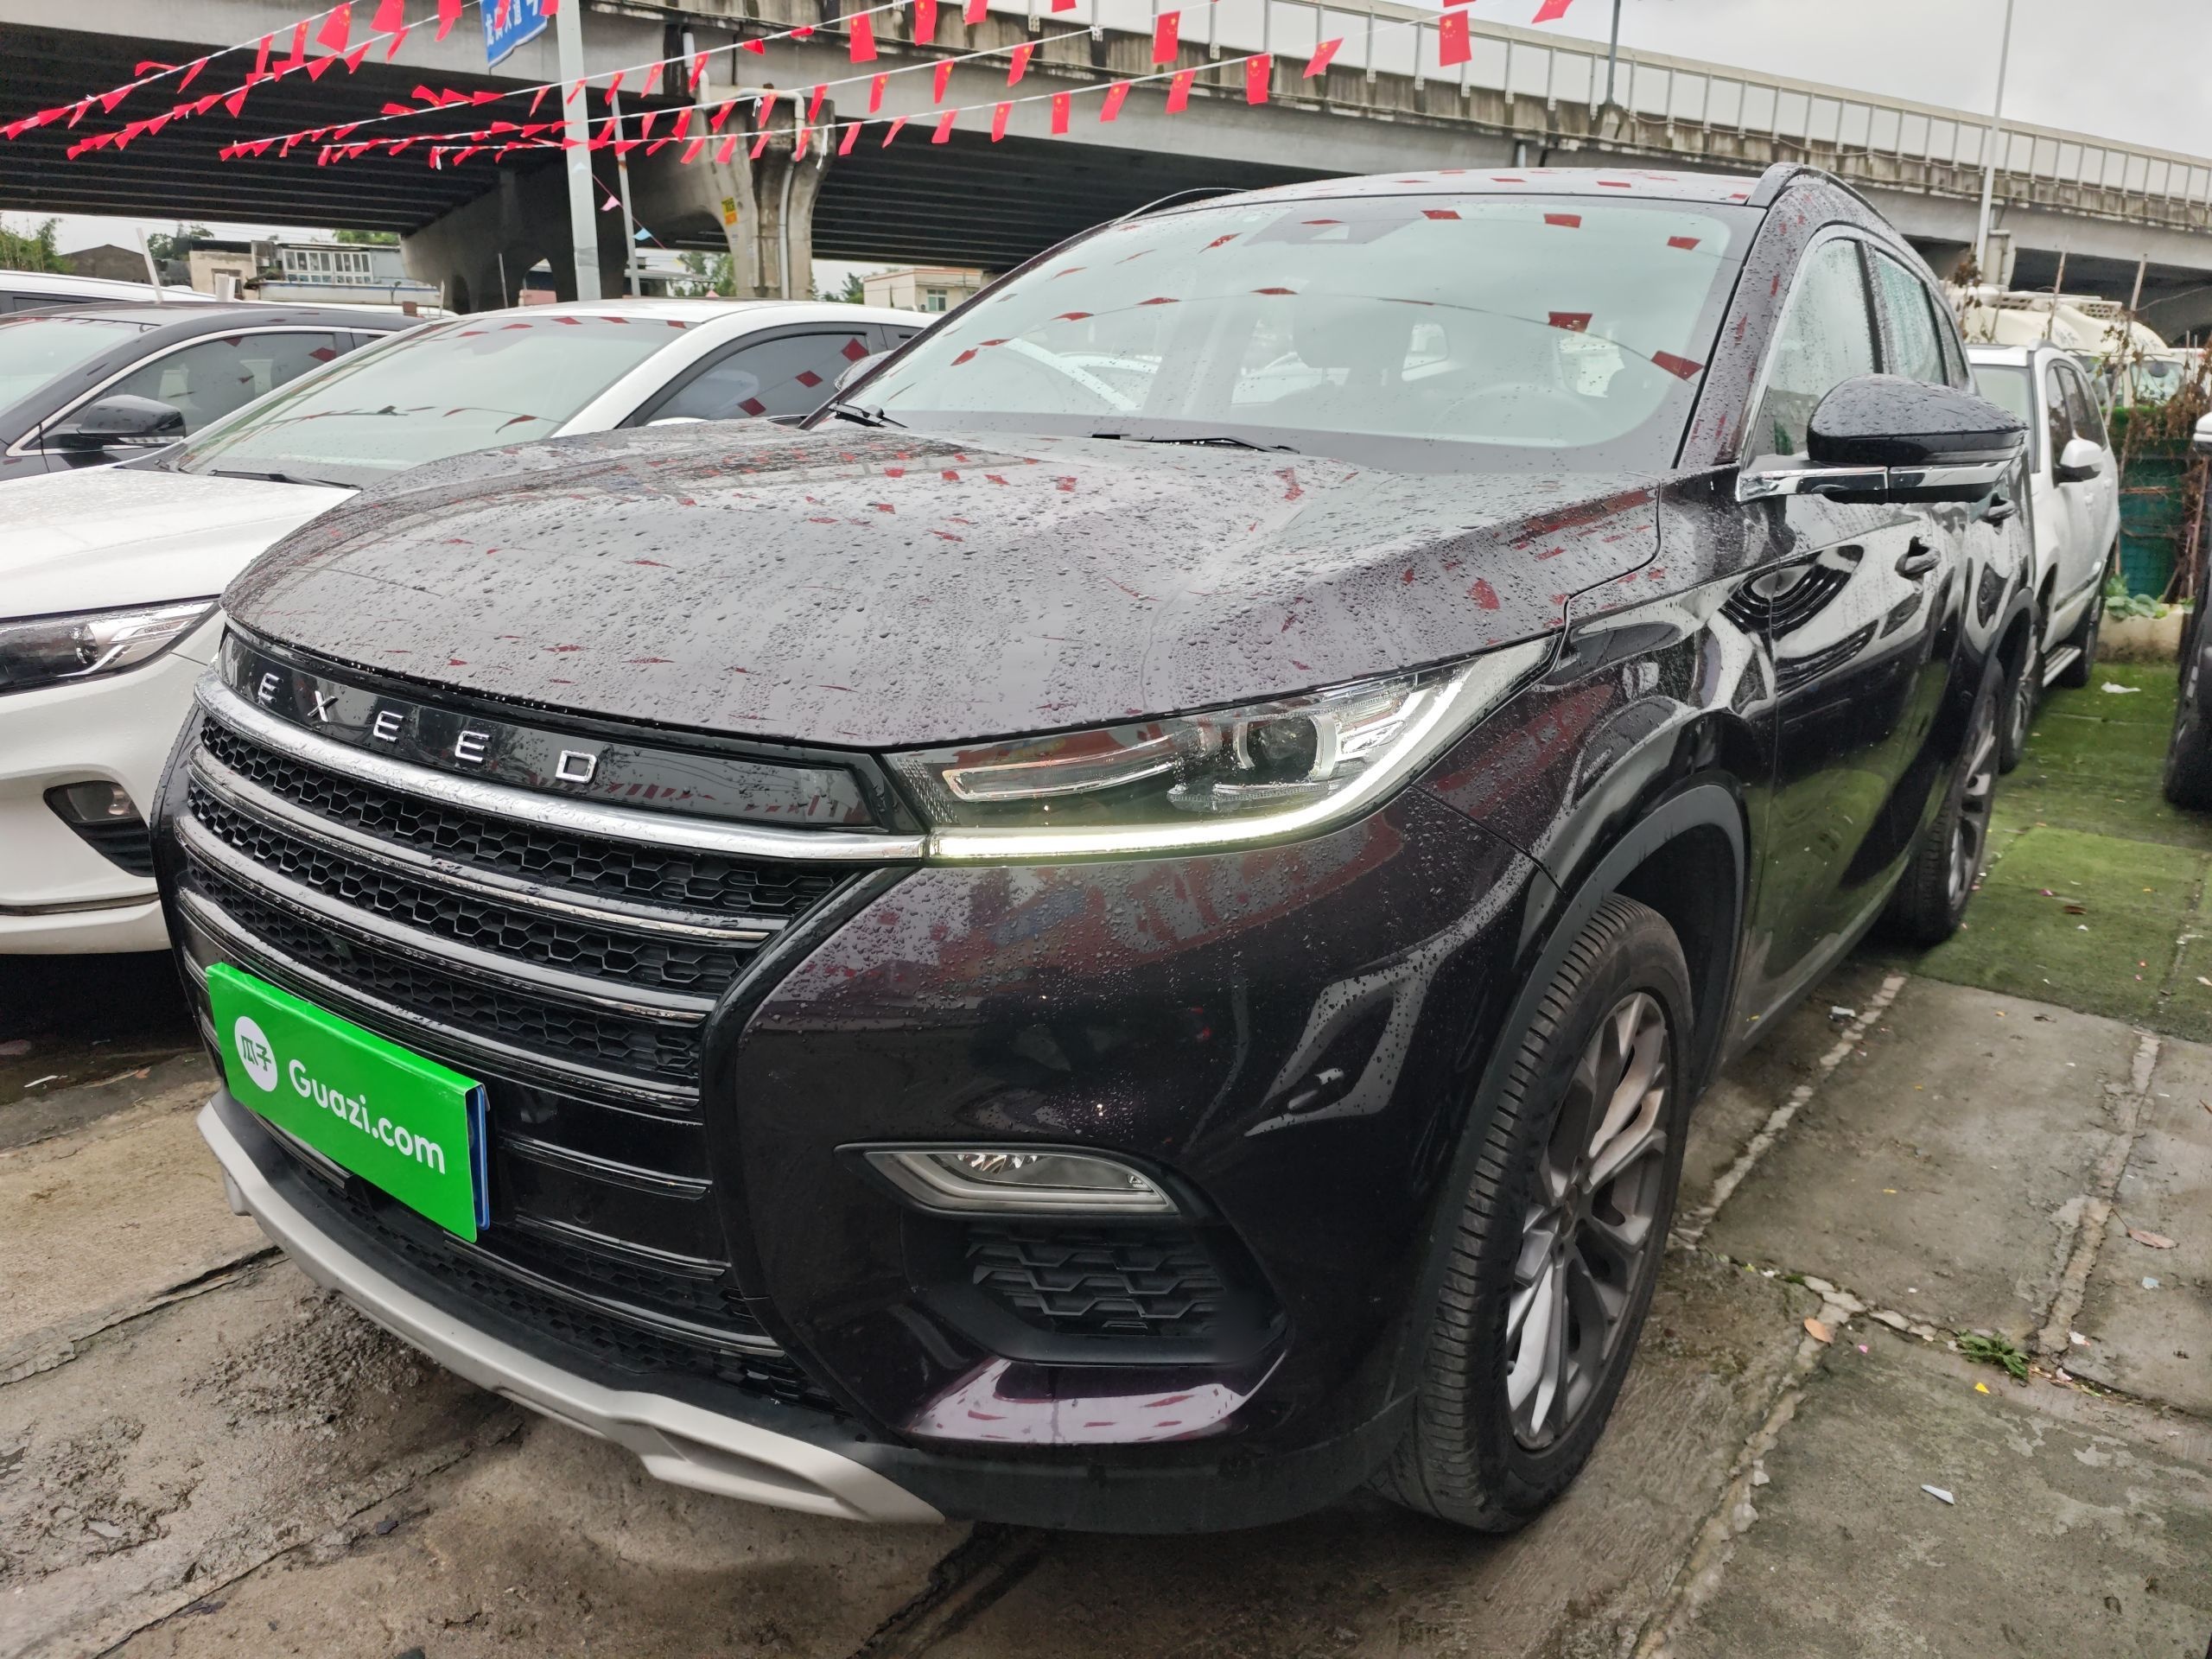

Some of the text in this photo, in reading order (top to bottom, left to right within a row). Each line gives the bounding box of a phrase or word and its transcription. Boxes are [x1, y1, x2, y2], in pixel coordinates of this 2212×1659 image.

[257, 671, 600, 785] EXEED
[240, 1034, 272, 1072] 瓜子
[289, 1059, 446, 1175] Guazi.com
